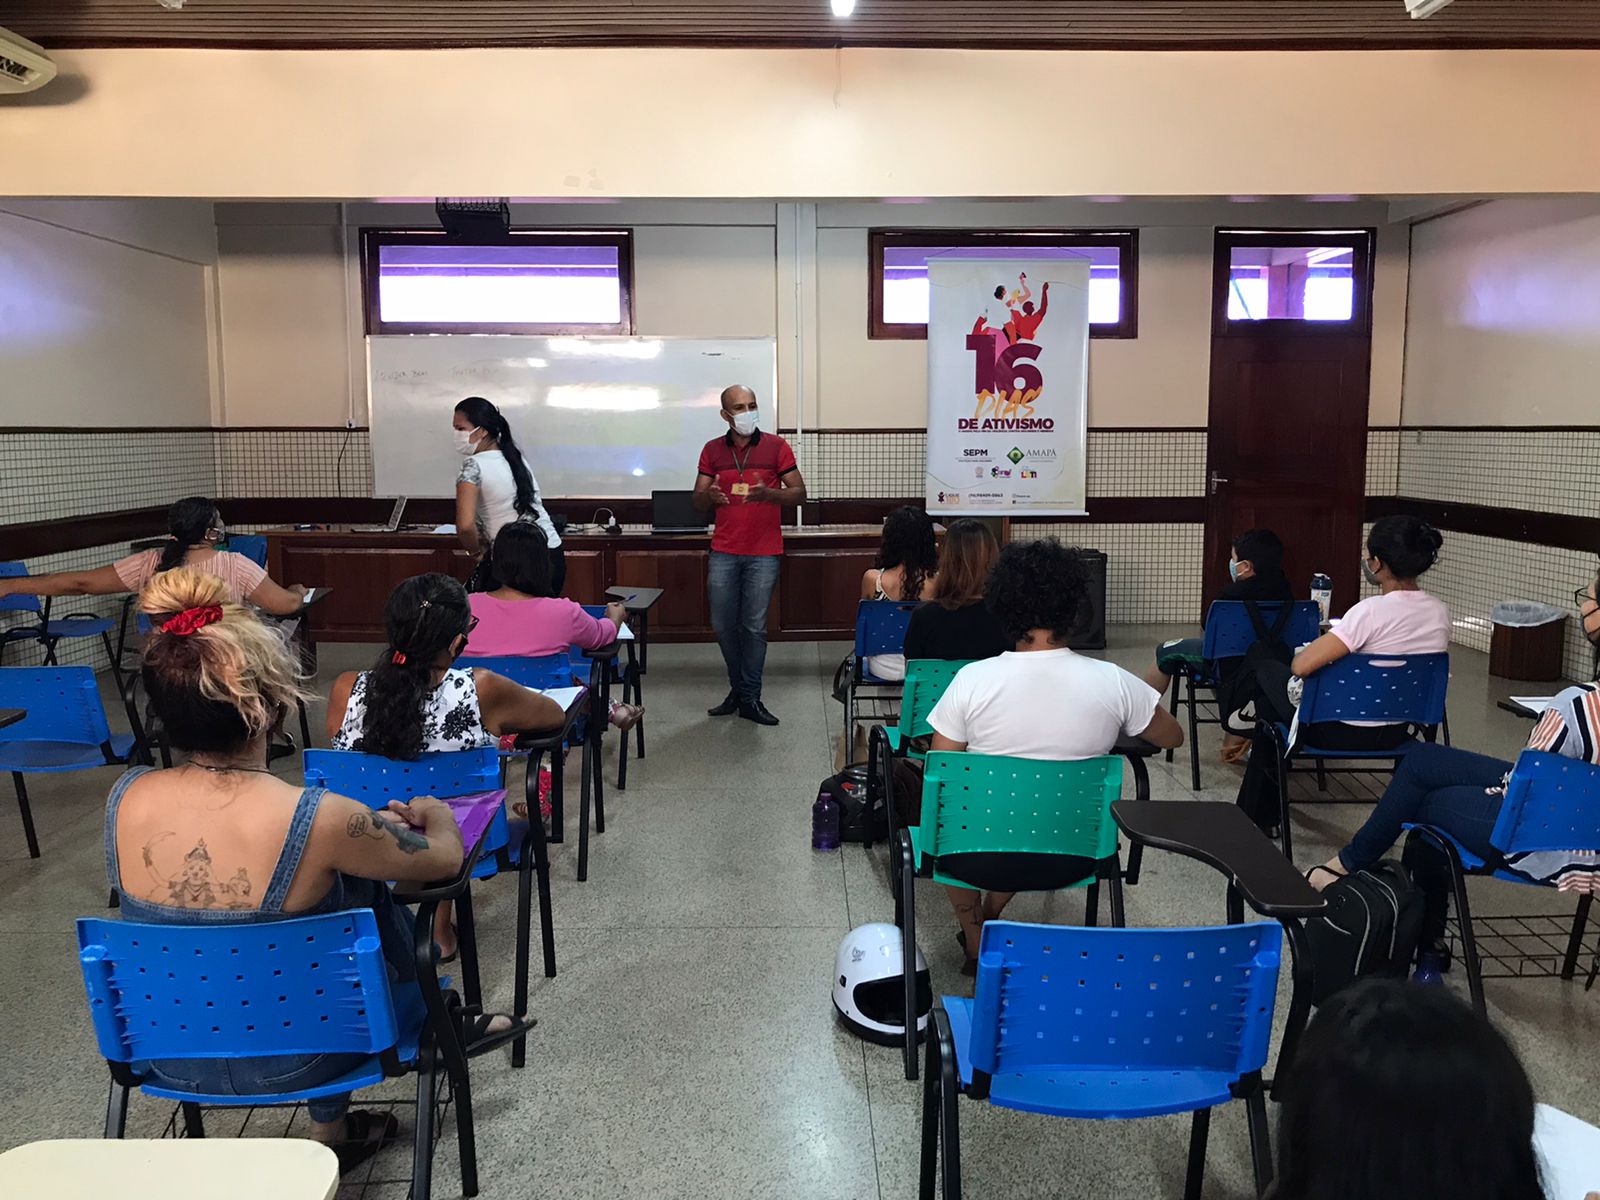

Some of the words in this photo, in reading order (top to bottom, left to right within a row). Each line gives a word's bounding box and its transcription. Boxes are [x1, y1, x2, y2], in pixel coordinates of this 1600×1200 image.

[966, 334, 1043, 404] 16
[974, 388, 1043, 419] DIAS
[958, 418, 979, 430] DE
[982, 418, 1054, 430] ATIVISMO
[963, 448, 988, 457] SEPM
[1026, 447, 1057, 457] AMAPÁ
